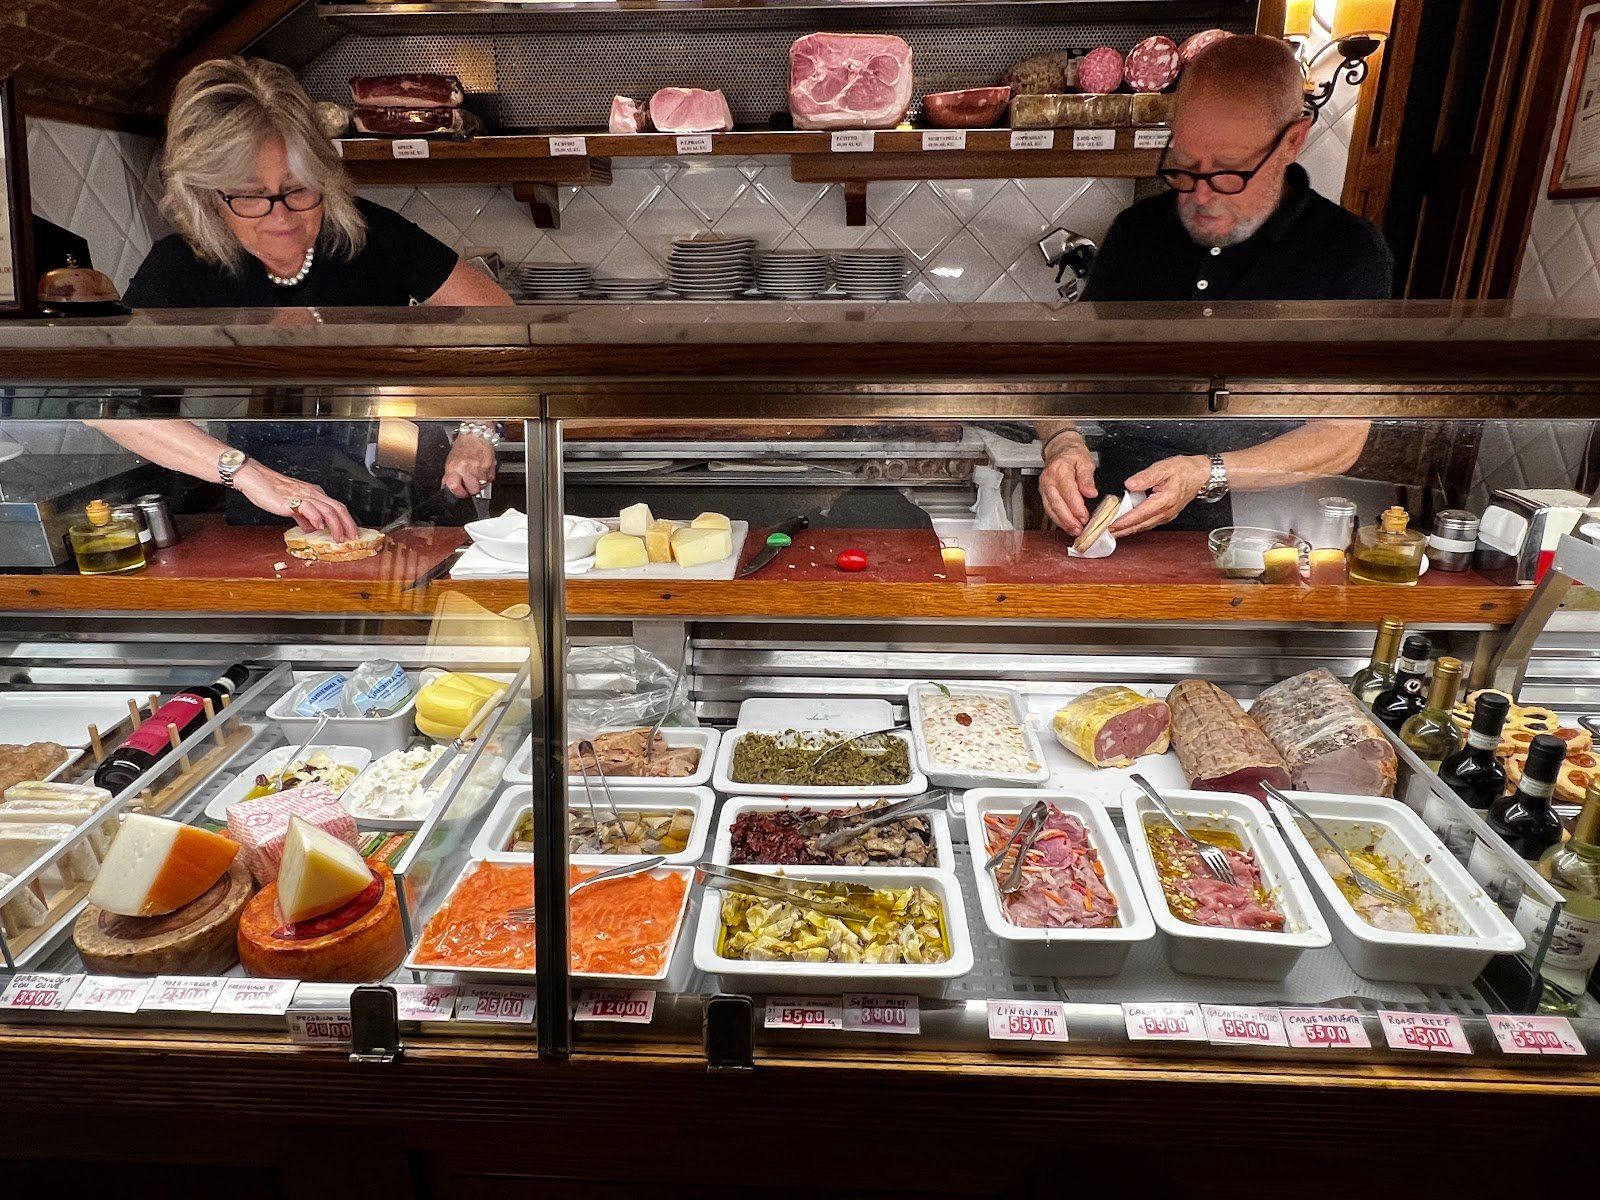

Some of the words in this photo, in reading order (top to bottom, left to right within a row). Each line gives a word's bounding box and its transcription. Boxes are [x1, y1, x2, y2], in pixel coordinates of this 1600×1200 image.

[997, 1006, 1039, 1016] LINGUA
[1387, 1014, 1415, 1024] ROAST
[1421, 1017, 1450, 1026] BEEF
